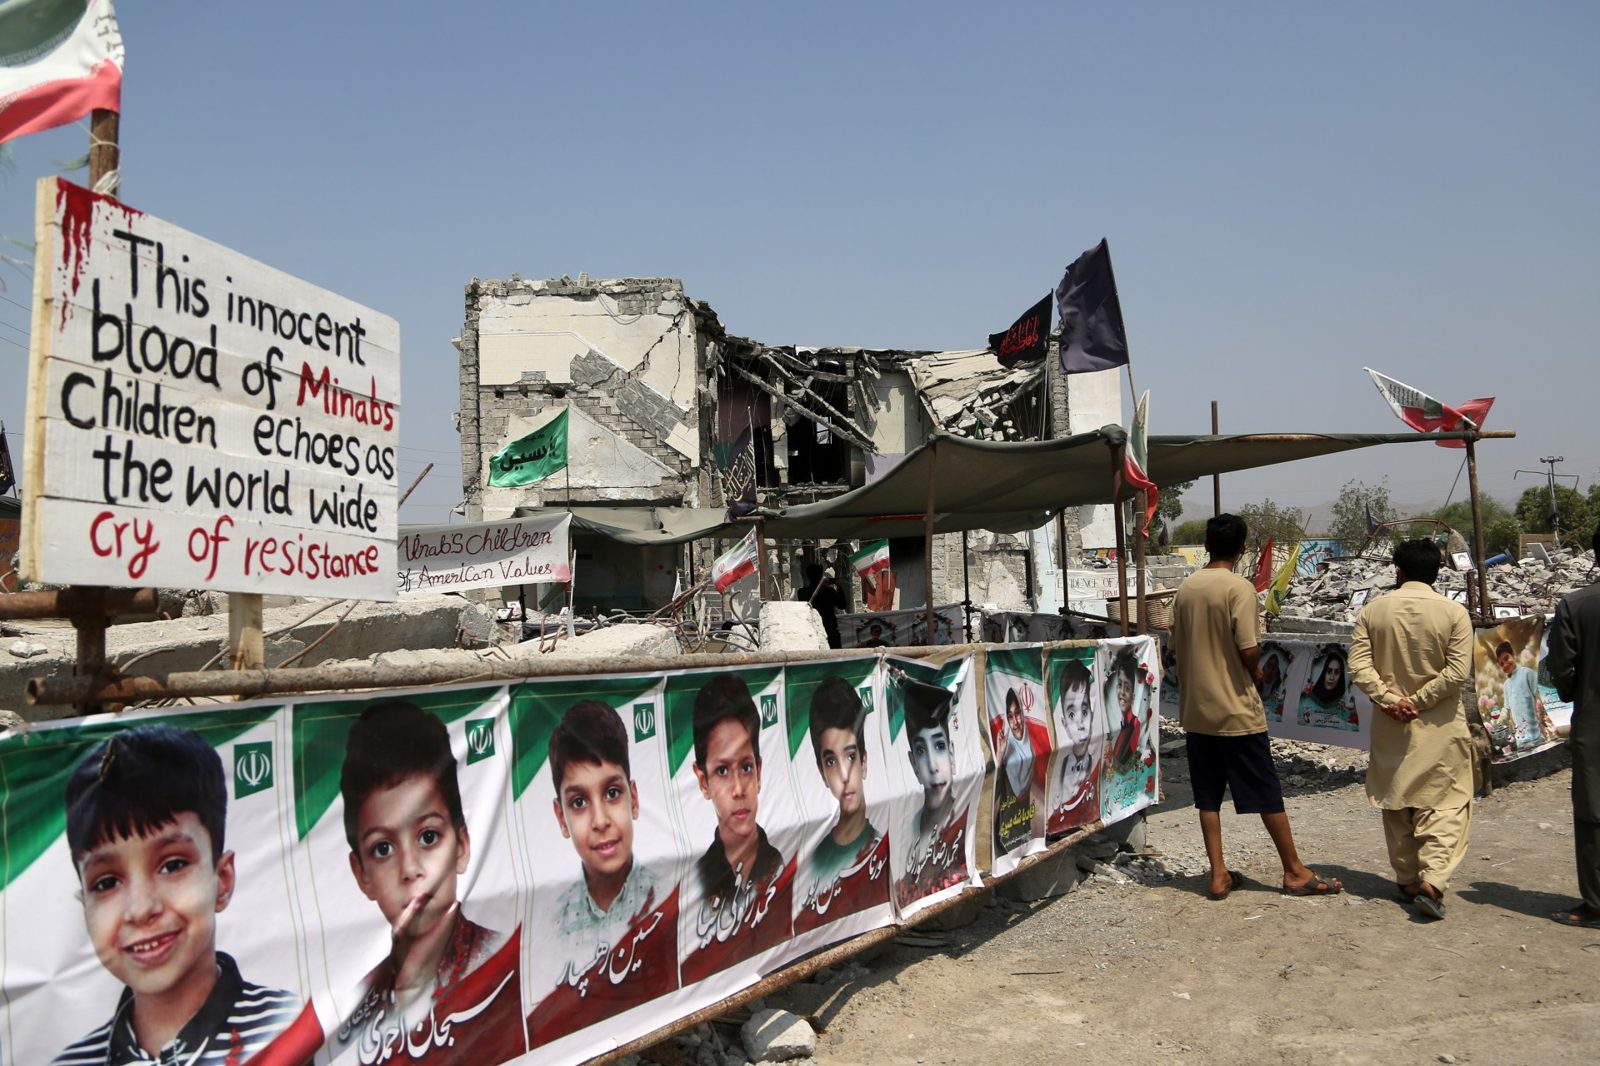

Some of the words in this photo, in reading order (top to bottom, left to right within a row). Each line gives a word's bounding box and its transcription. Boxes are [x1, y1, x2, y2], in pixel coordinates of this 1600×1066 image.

[113, 229, 209, 317] This
[226, 276, 366, 366] innocent
[91, 278, 220, 391] blood
[242, 346, 283, 409] of
[297, 361, 394, 431] Minabs
[61, 369, 217, 448] Children
[254, 415, 359, 476] echoes
[366, 445, 394, 480] as
[93, 435, 173, 504] the
[186, 466, 292, 516] world
[310, 483, 378, 532] wide
[90, 511, 160, 579] Cry
[188, 514, 234, 581] of
[245, 533, 380, 580] resistance
[499, 556, 552, 579] Values
[1057, 577, 1097, 588] EIDENCE
[609, 911, 664, 985] حسین
[407, 969, 515, 1058] سبحان
